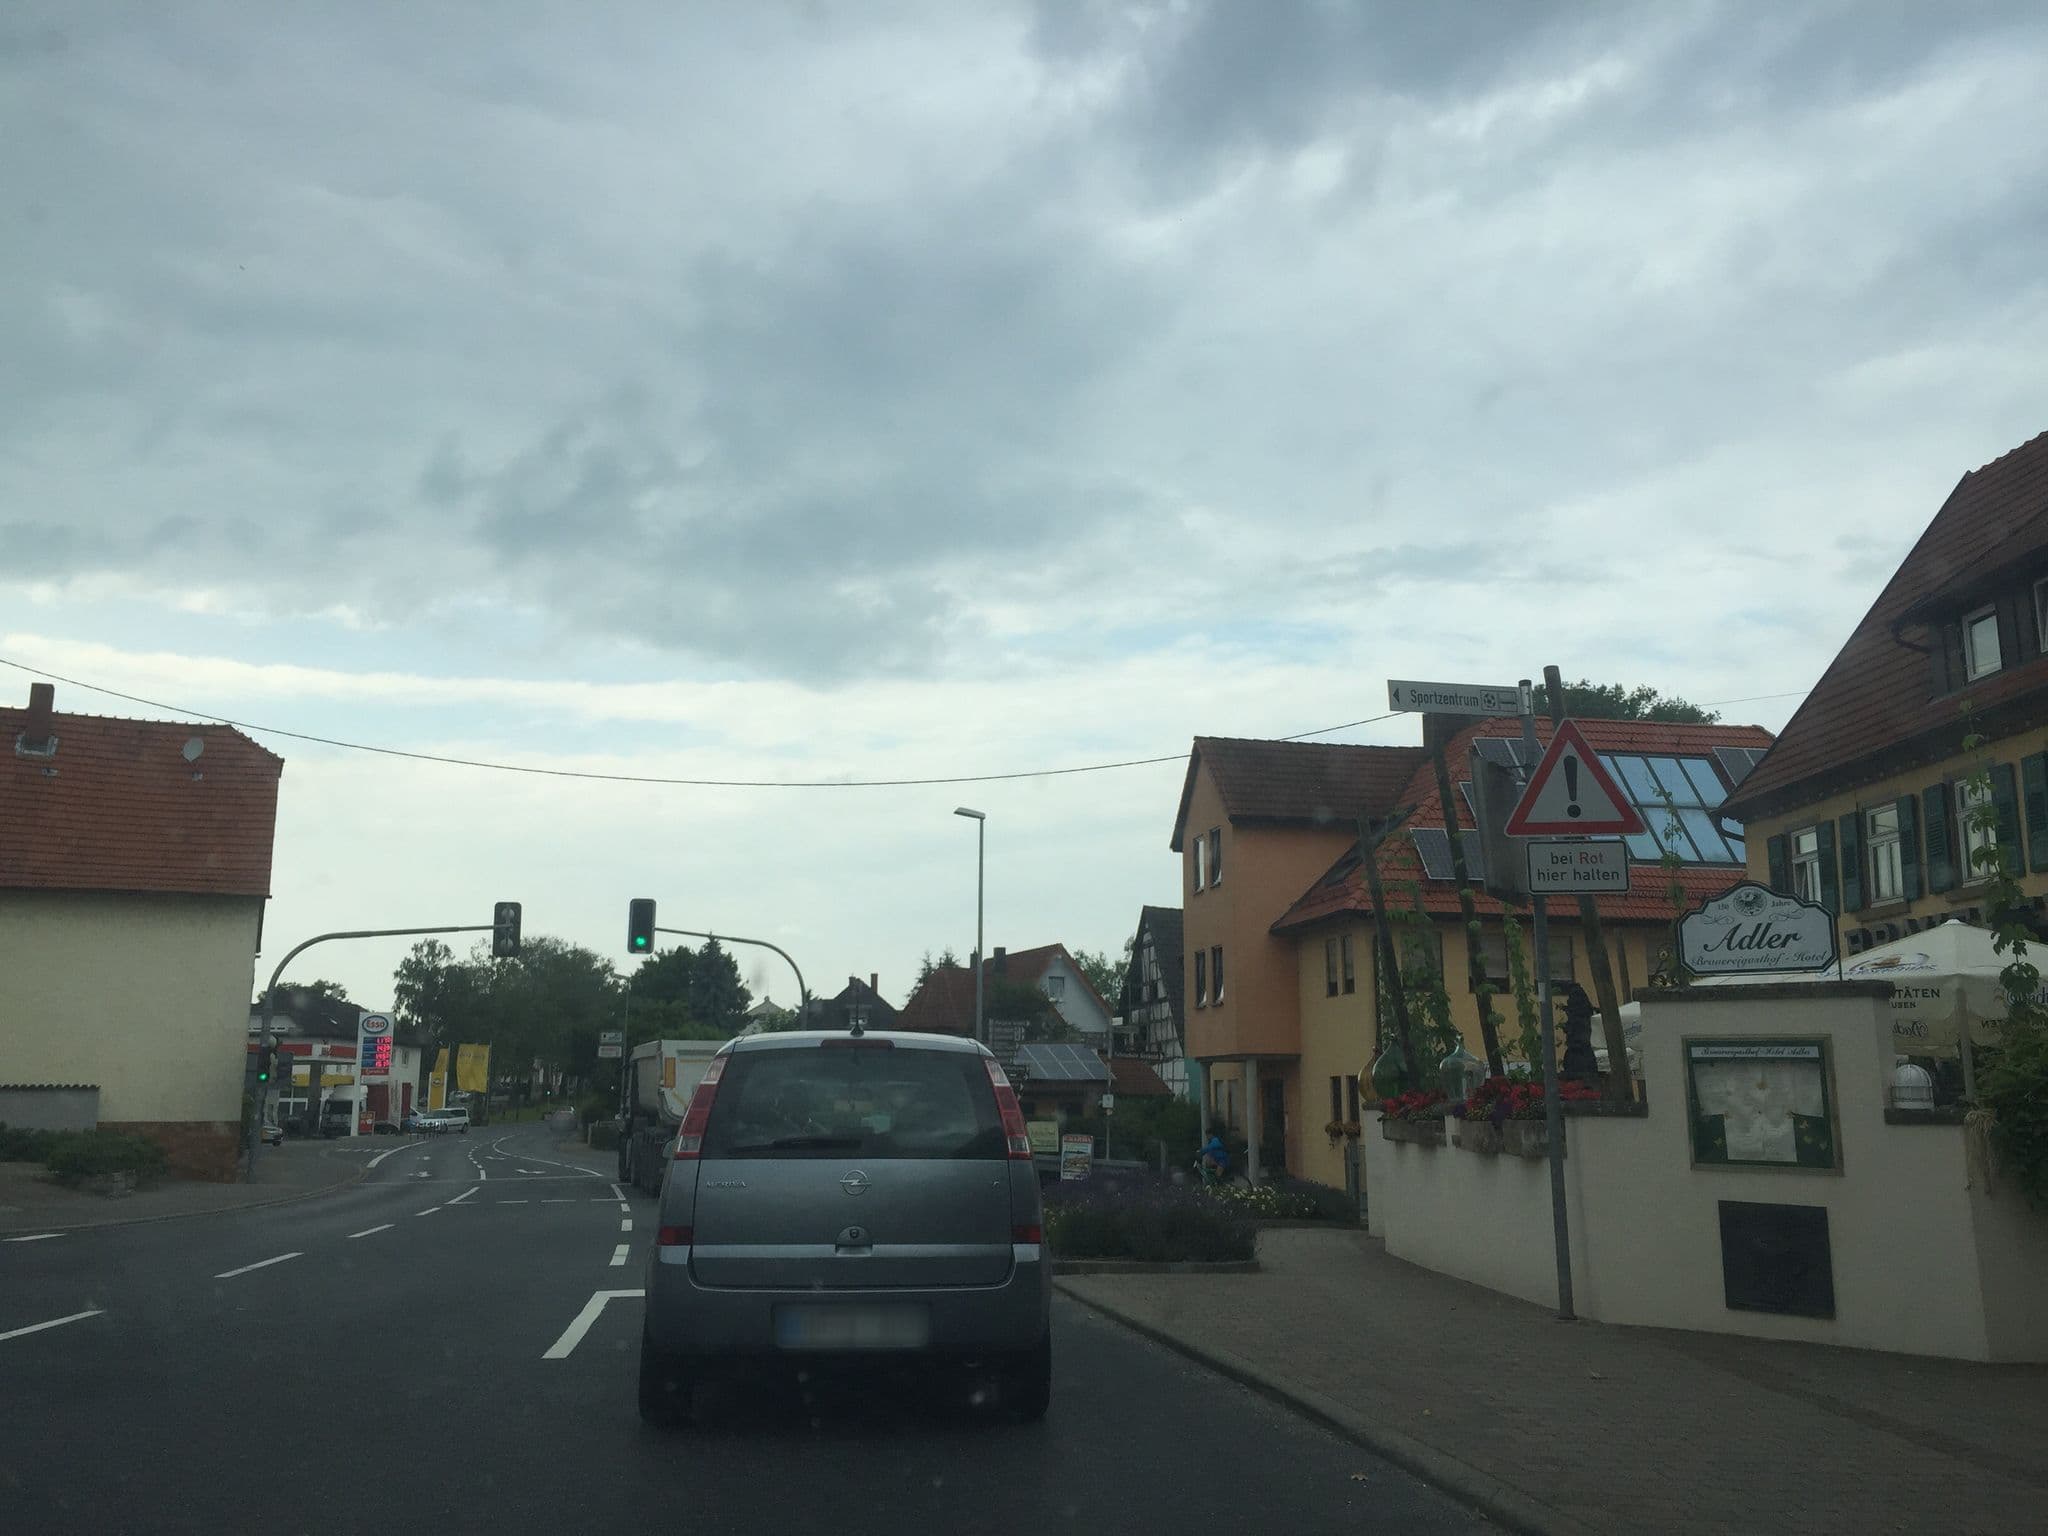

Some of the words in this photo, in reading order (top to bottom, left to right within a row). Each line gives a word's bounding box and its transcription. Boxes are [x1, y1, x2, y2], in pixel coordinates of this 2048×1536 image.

[1410, 689, 1479, 706] Sportzentrum
[1551, 851, 1573, 865] bei
[1579, 851, 1604, 865] Rot
[1537, 868, 1566, 881] hier
[1573, 867, 1620, 881] halten
[1703, 922, 1802, 953] Adler
[1691, 952, 1783, 967] Brauereigasthof
[1792, 951, 1828, 963] Hotel
[1889, 986, 1941, 999] TÄTEN
[1890, 1001, 1917, 1009] USEN
[366, 1019, 385, 1028] Esso
